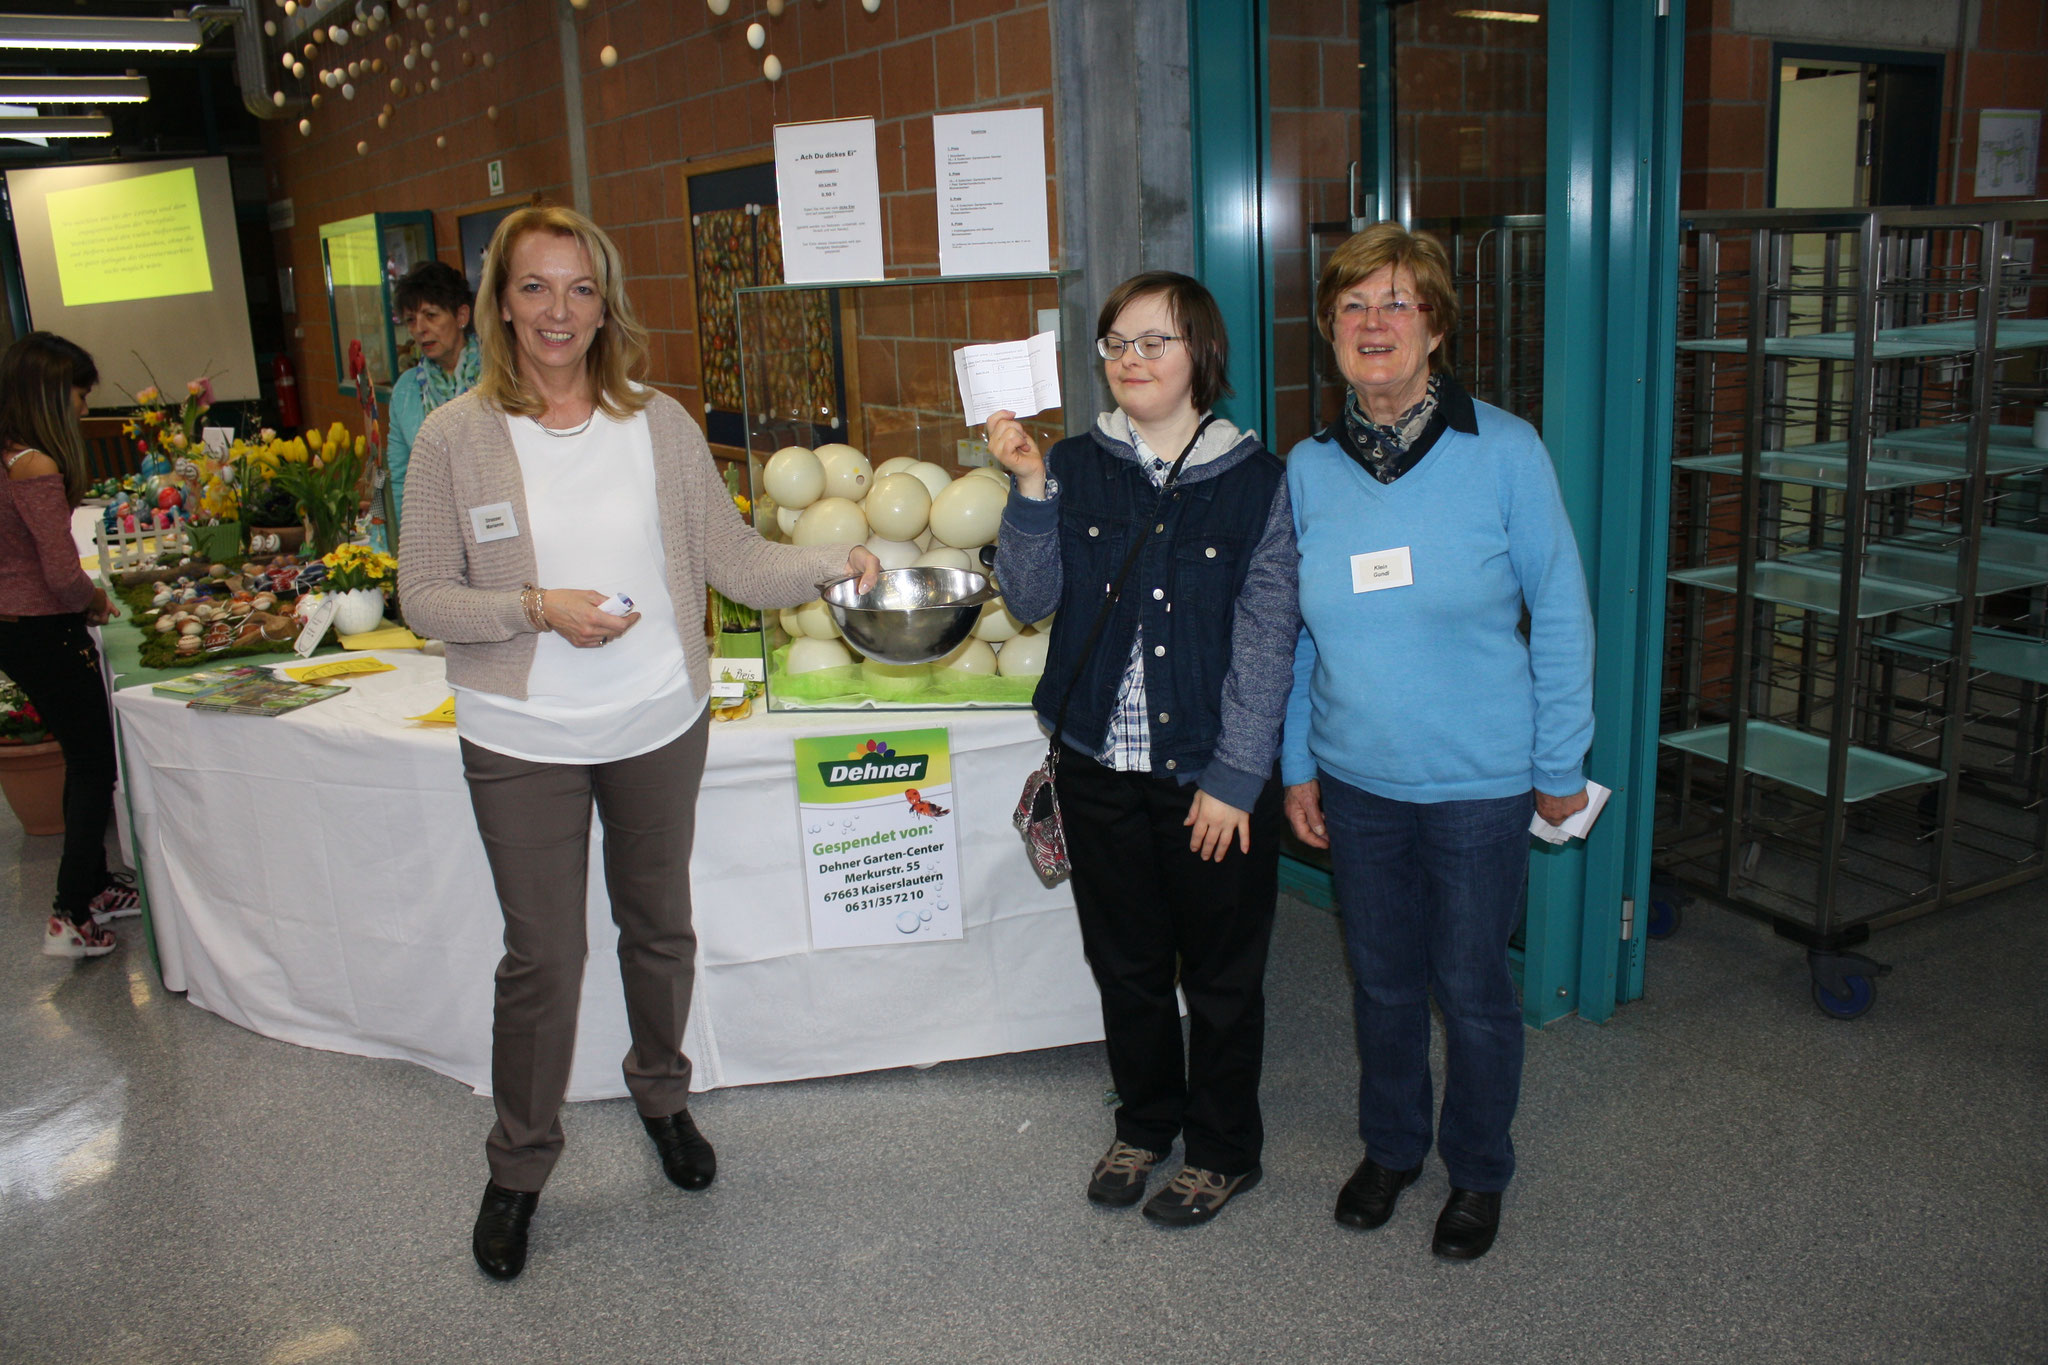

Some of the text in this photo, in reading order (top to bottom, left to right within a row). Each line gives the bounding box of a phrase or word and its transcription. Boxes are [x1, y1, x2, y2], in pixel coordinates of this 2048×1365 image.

[829, 761, 922, 783] Dehner
[812, 824, 933, 856] Gespendet von:
[819, 842, 945, 874] Dehner Garten-Center
[844, 861, 920, 884] Merkurstr. 55
[824, 872, 944, 902] 67663 Kaiserslautern
